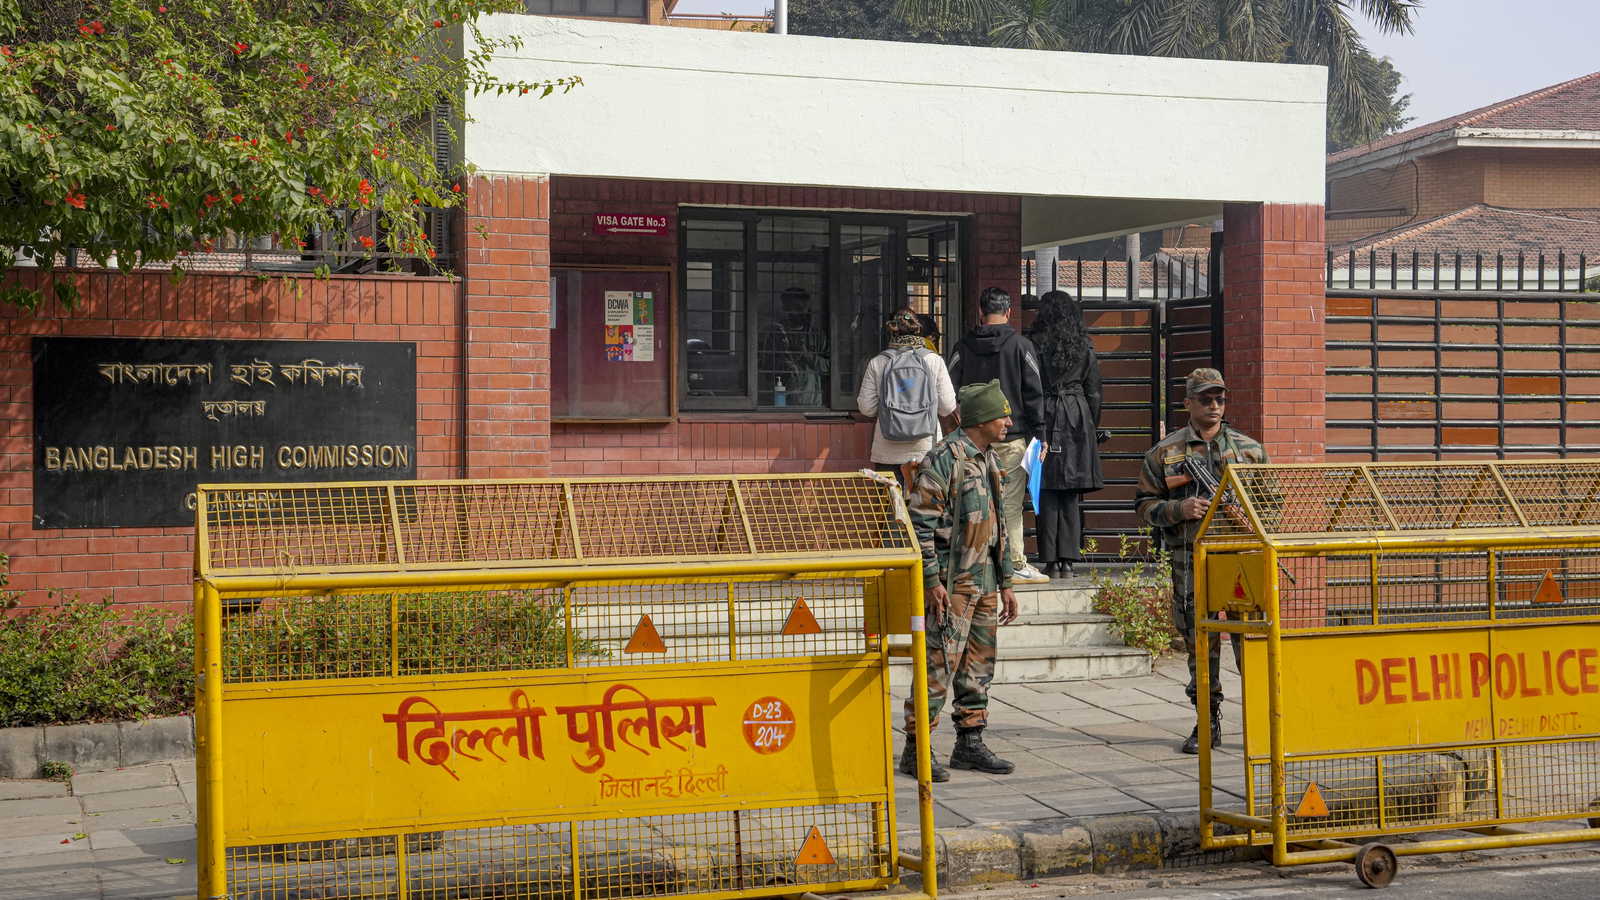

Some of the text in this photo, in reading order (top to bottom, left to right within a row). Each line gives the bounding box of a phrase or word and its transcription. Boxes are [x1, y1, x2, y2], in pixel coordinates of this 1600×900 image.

[596, 215, 666, 227] VISA GATE No.3
[97, 358, 364, 388] বাংলাদেশ হাই কমিশন
[45, 444, 410, 472] BANGLADESH HIGH COMMISSION
[1355, 648, 1600, 706] DELHI POLICE
[753, 701, 782, 719] D-23
[383, 683, 717, 781] दिल्ली पुलिस
[754, 726, 786, 747] 204
[600, 773, 643, 799] जिला
[677, 764, 728, 797] दिल्ली
